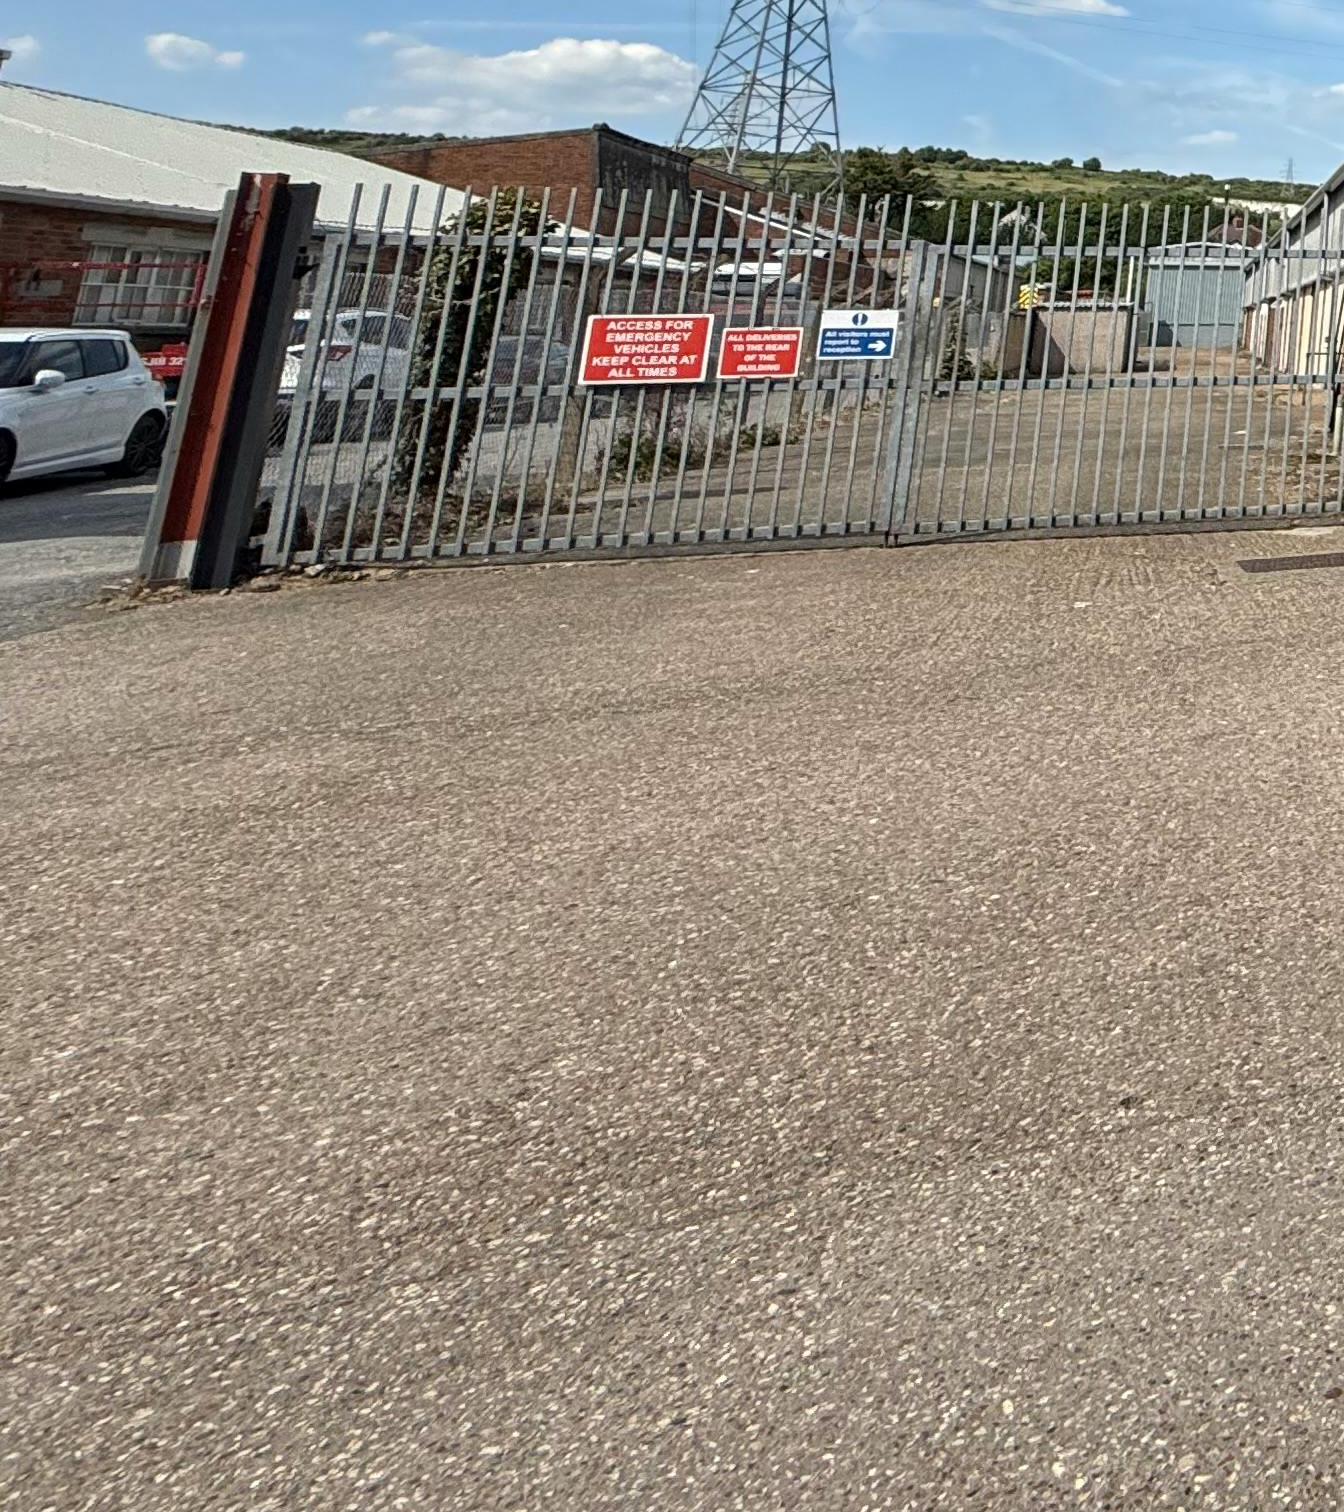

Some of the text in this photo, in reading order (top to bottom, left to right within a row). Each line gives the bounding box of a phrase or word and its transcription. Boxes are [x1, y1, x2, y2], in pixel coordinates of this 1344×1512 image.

[606, 320, 694, 330] ACCESS FOR
[605, 332, 692, 343] EMERGENCY
[727, 334, 797, 342] ALL DELIVERIES
[613, 343, 680, 354] VEHICLES
[592, 355, 698, 366] KEEP CLEAR AT
[607, 367, 678, 378] ALL TIMES
[736, 364, 781, 372] BUILDING
